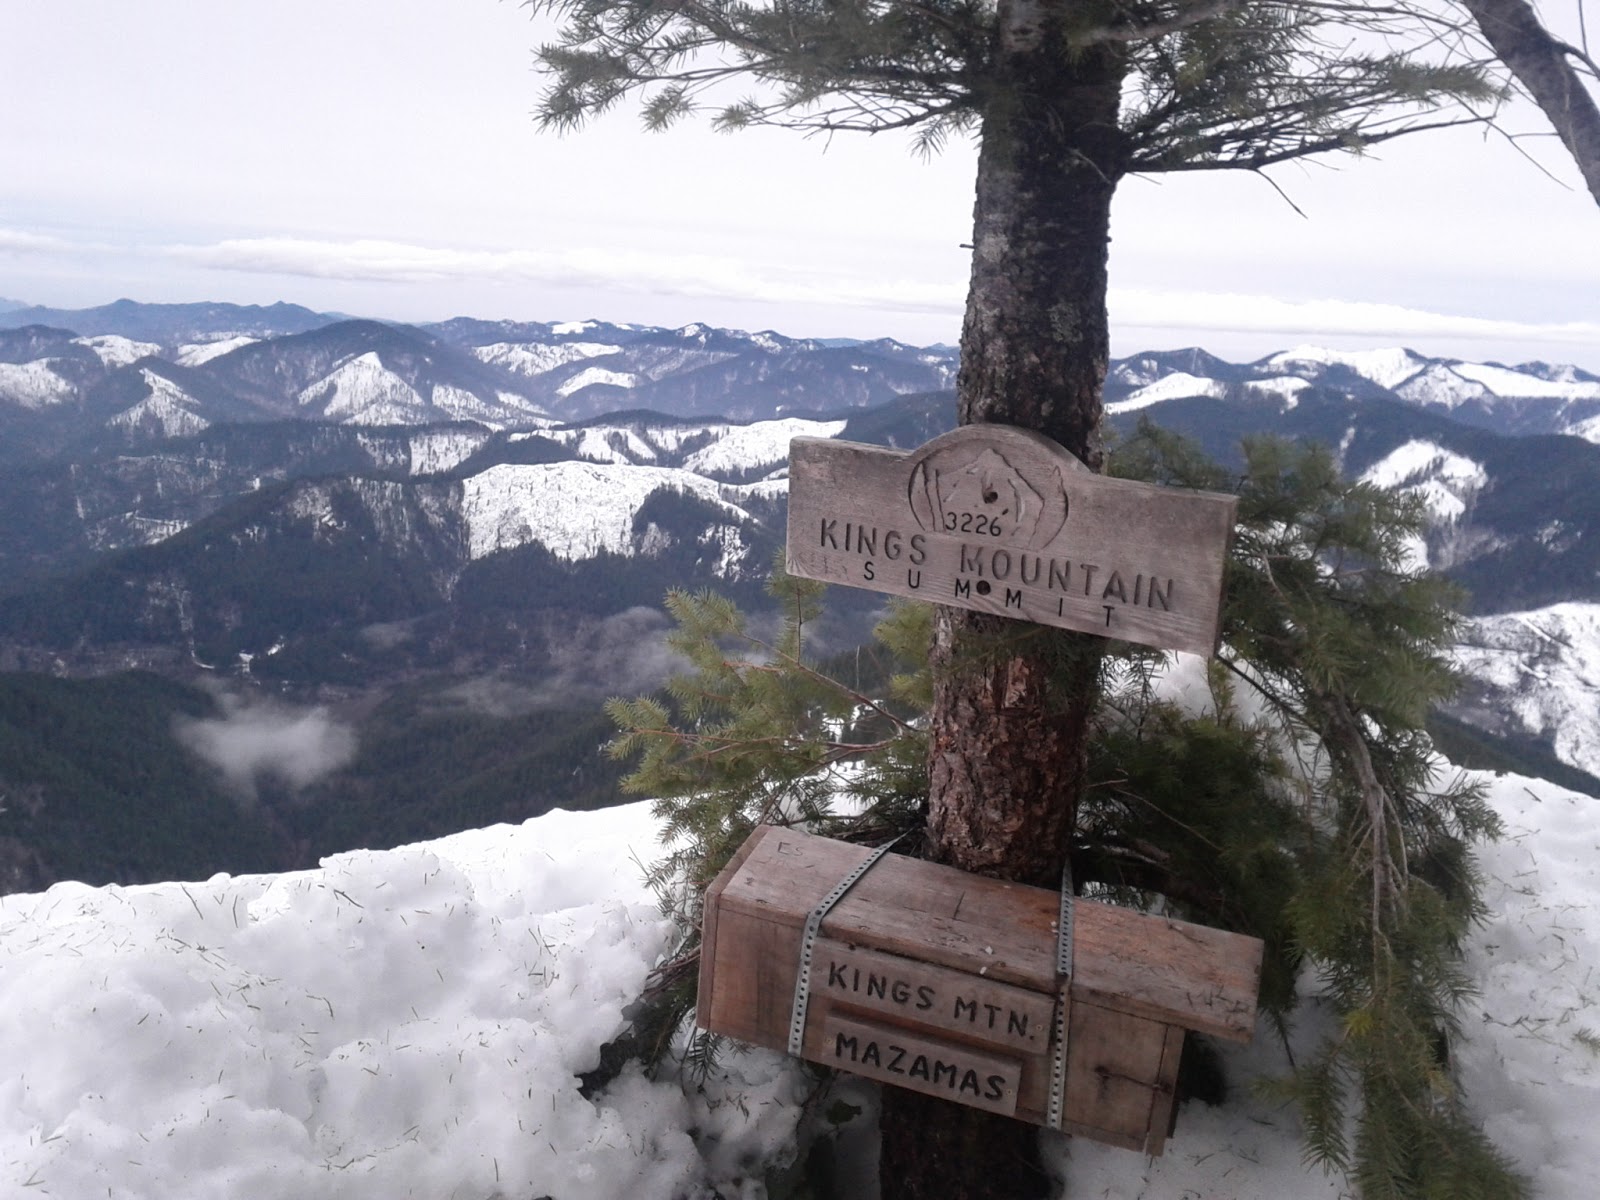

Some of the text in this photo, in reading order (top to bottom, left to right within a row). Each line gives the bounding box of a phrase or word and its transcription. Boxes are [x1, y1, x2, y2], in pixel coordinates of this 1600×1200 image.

[820, 517, 1174, 612] KINGS MOUNTAIN
[863, 560, 1115, 628] SUMMIT
[828, 961, 1036, 1041] KINGS MTN.
[835, 1032, 1006, 1100] MAZAMAS
